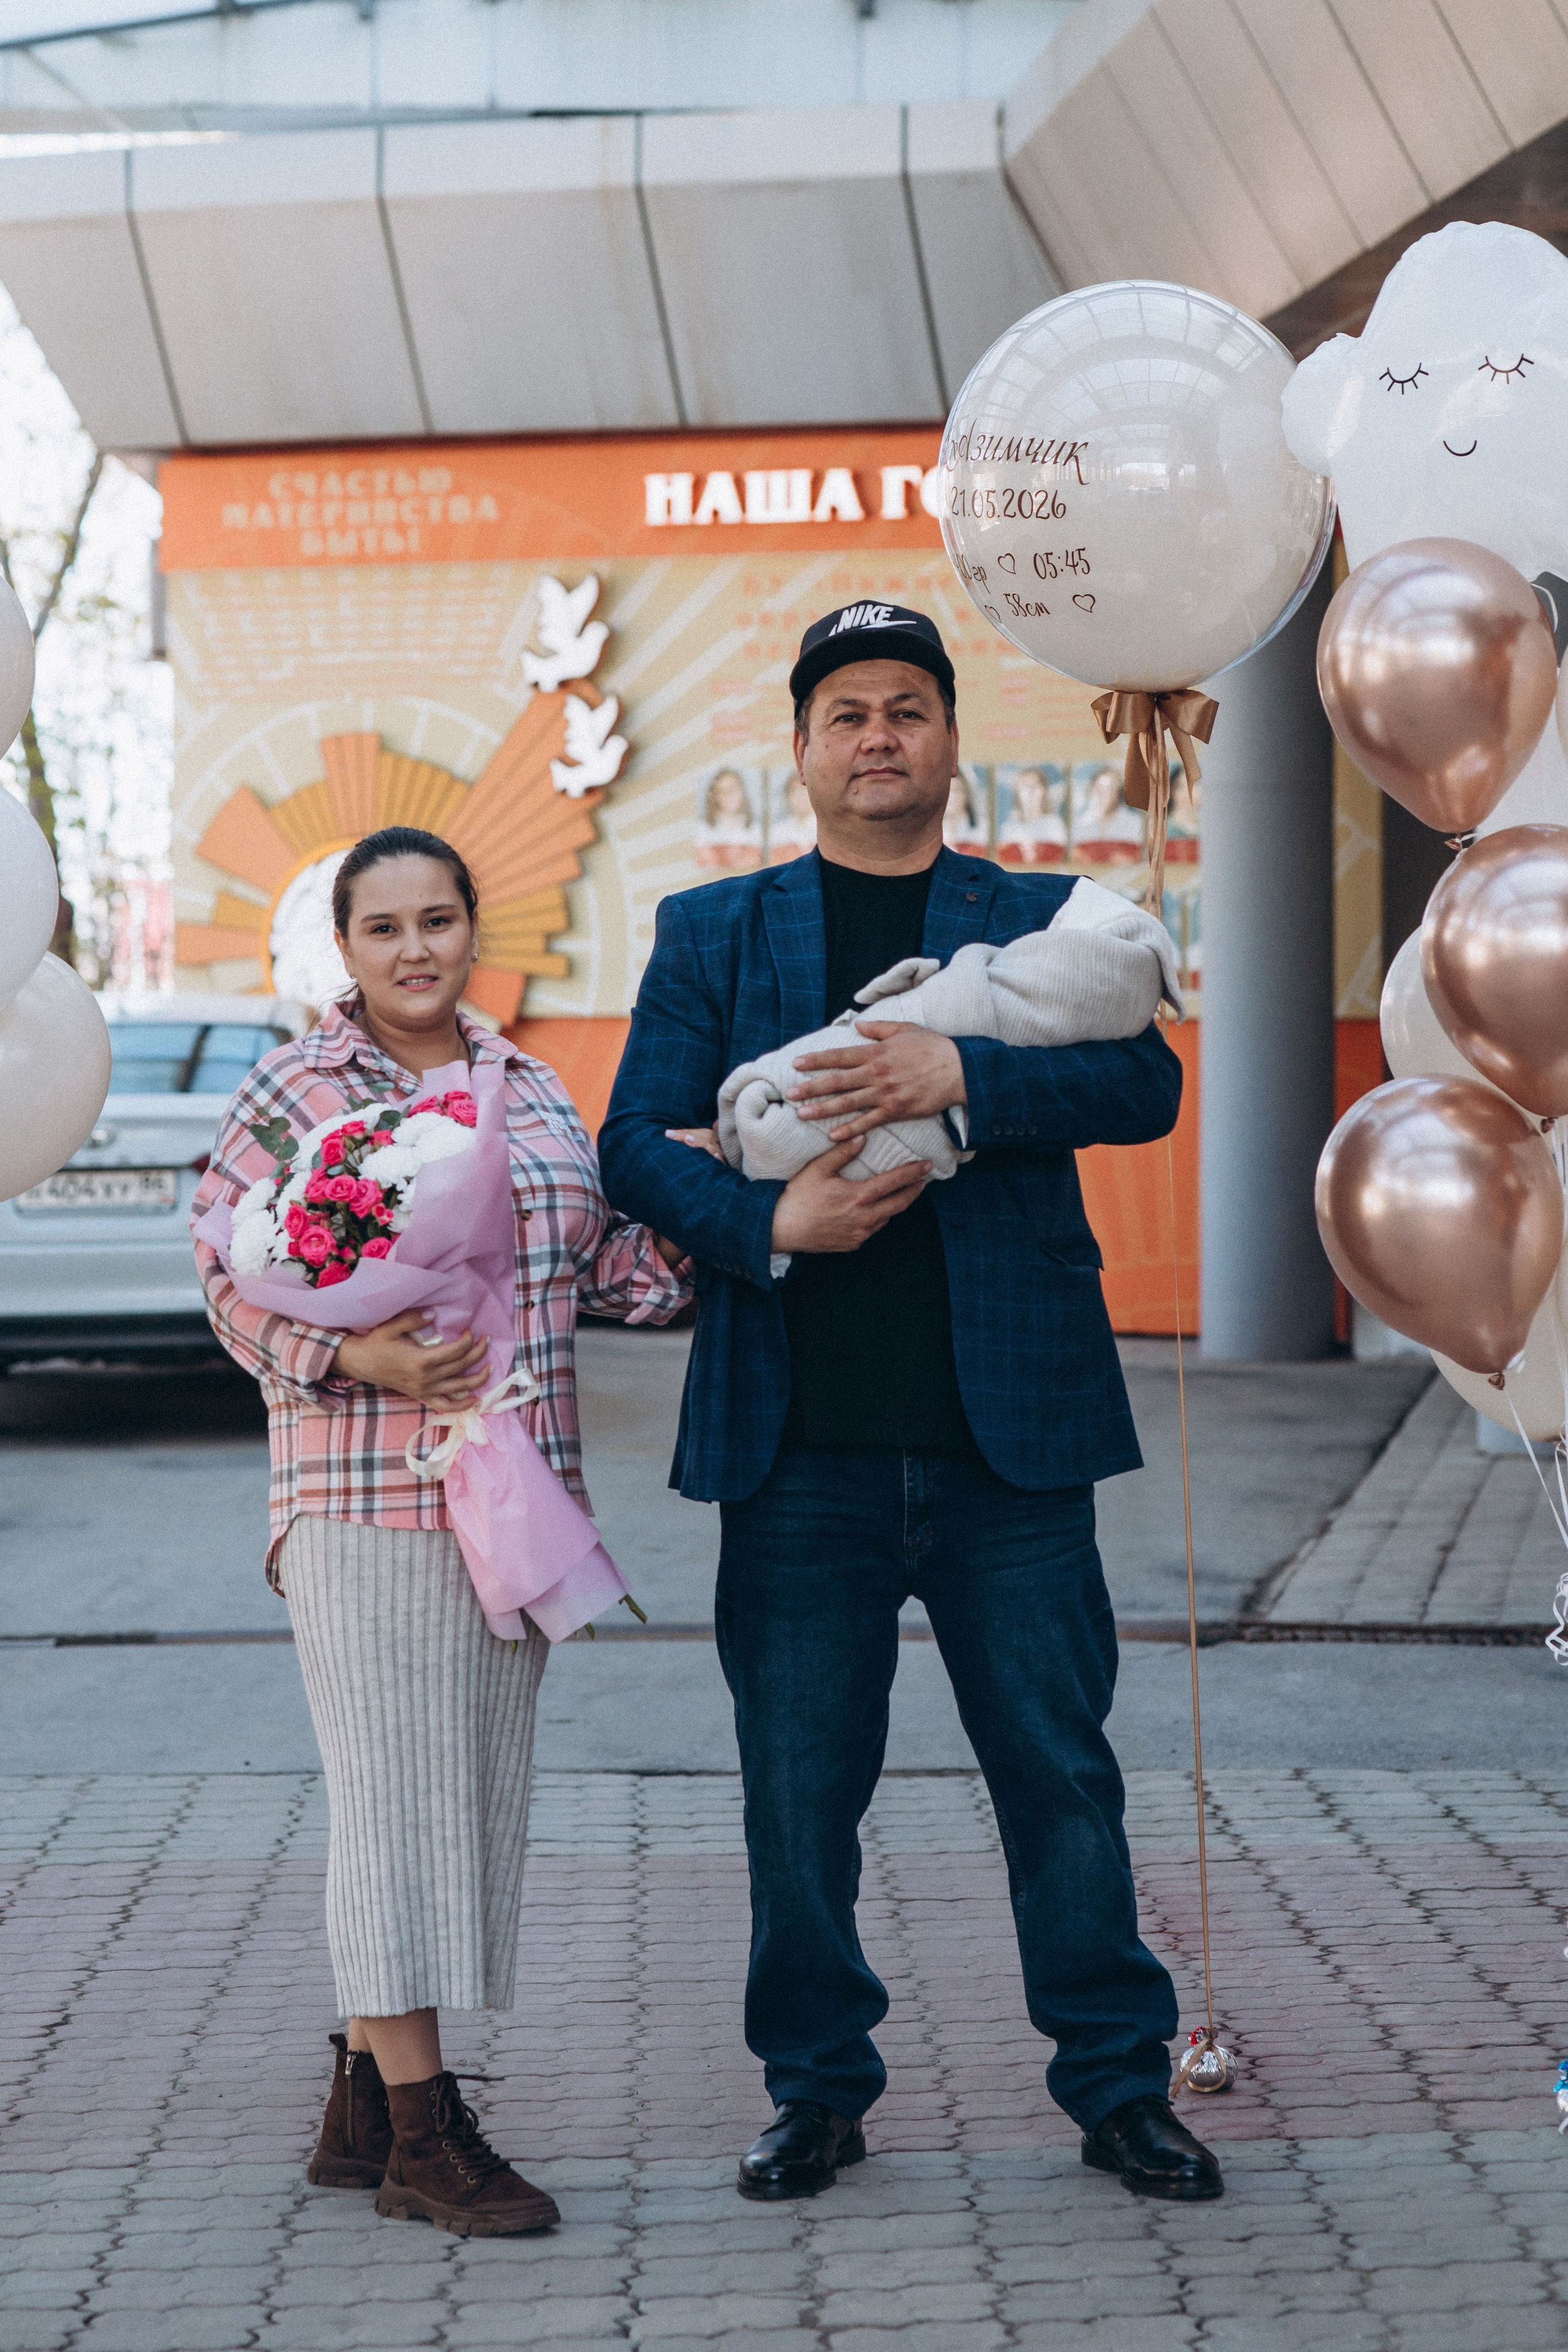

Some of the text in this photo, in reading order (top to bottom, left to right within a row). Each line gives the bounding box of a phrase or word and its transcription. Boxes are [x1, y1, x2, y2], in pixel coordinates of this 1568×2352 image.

[222, 496, 498, 529] МАТЕРИНСТВА
[645, 469, 863, 526] НАША
[951, 486, 1066, 519] 21.05.2026
[1033, 546, 1091, 579] 05:45
[837, 604, 894, 633] NIKE
